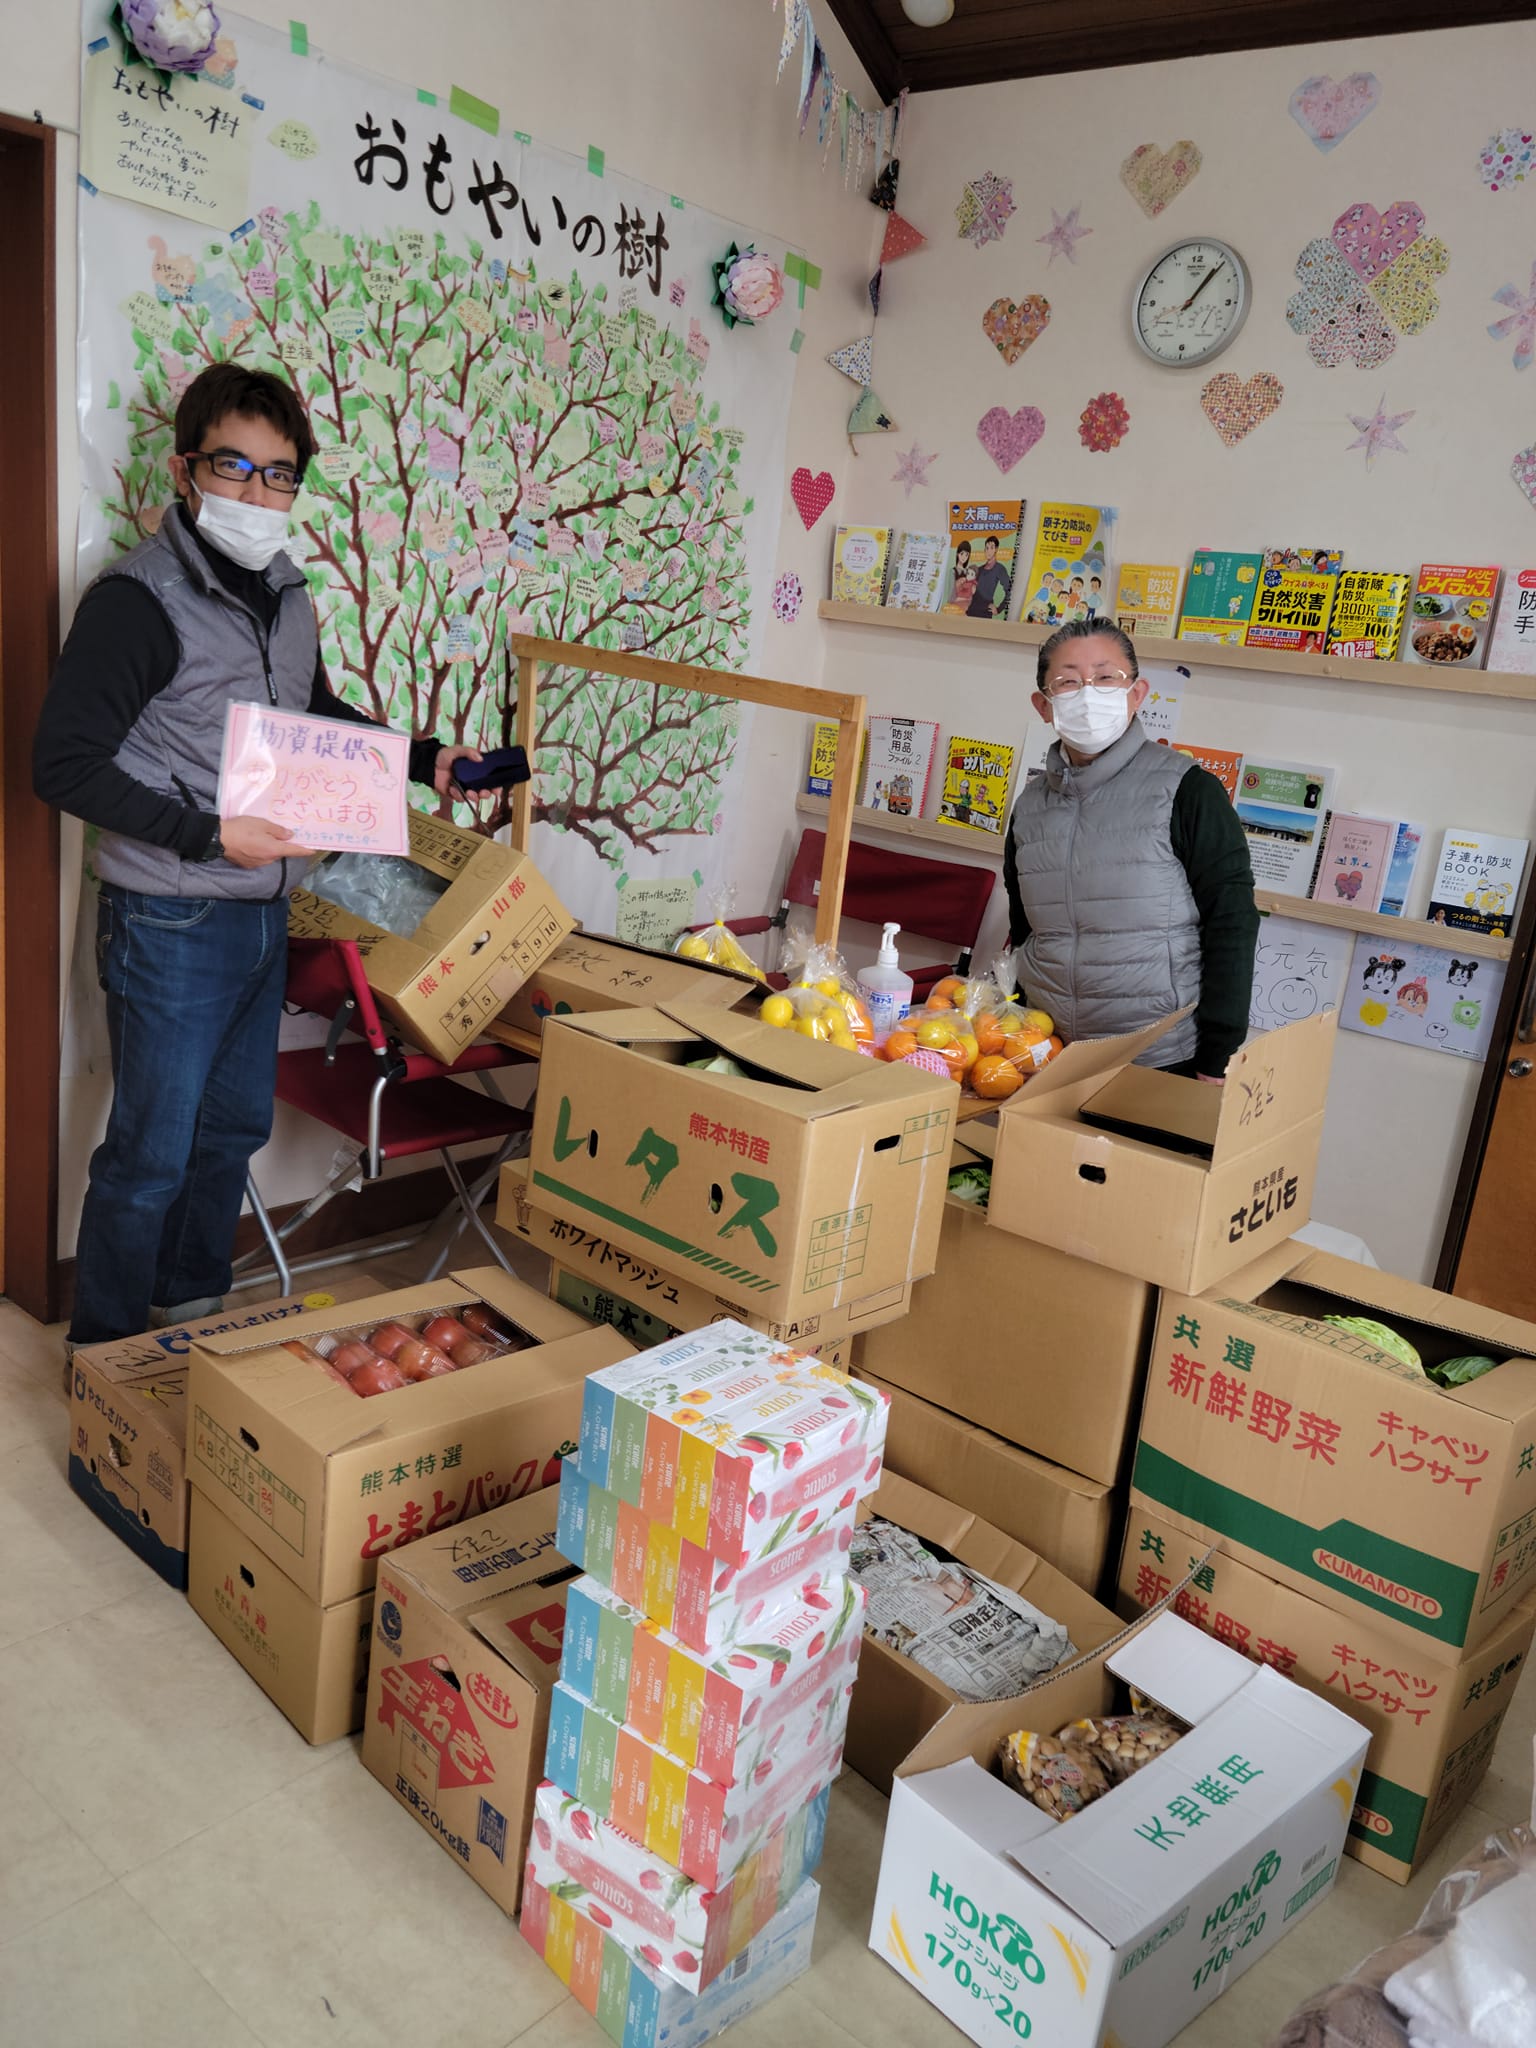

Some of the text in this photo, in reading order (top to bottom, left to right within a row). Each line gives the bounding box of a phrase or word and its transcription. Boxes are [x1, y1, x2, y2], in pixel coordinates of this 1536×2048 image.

[112, 66, 240, 138] おもやいの樹
[353, 112, 671, 297] おもやいの樹
[1191, 255, 1204, 263] 12
[1043, 516, 1092, 533] 原子力防災の
[1043, 530, 1069, 542] てびき
[905, 571, 924, 583] 防災
[908, 559, 927, 570] 親子
[1467, 569, 1494, 580] レシピ
[1148, 578, 1173, 594] 防災
[1260, 588, 1326, 612] 自然災害
[1342, 590, 1365, 602] 防災
[1344, 577, 1385, 591] 自衛隊
[1146, 595, 1171, 610] 手帖
[1258, 607, 1321, 627] サバイバル
[1340, 602, 1376, 616] BOOK
[1364, 623, 1394, 638] 100
[1514, 615, 1534, 634] 手
[1331, 641, 1356, 658] 30
[1356, 640, 1375, 650] 万部
[255, 718, 370, 762] 物資提供
[891, 740, 912, 753] 用品
[892, 728, 914, 742] 防災
[969, 747, 991, 758] ぼくらの
[816, 748, 837, 763] 防災
[888, 754, 922, 766] ファイル 2
[963, 755, 1006, 778] サバイバル
[247, 763, 358, 800] ありがとう
[272, 793, 379, 831] ございます
[1444, 862, 1490, 877] BOOK
[1446, 849, 1512, 869] 子連れ防災
[417, 875, 527, 999] 熊本 山都
[533, 938, 542, 949] 9
[544, 922, 557, 936] 10
[521, 953, 530, 963] 8
[482, 996, 491, 1006] 5
[460, 1015, 473, 1033] 秀
[687, 1112, 772, 1166] 熊本特産
[552, 1095, 781, 1258] レタス
[1252, 1166, 1285, 1197] 熊本県産
[1229, 1176, 1299, 1244] さといも
[549, 1218, 680, 1305] ホワイトマッシュ
[811, 1258, 818, 1270] L
[812, 1240, 824, 1253] LL
[808, 1275, 819, 1288] M
[199, 1304, 304, 1337] やさしさバナナ
[593, 1292, 640, 1335] 熊本
[788, 1321, 799, 1339] A
[658, 1343, 705, 1365] scottie
[1171, 1314, 1257, 1372] 共選
[689, 1358, 736, 1382] scottie
[720, 1374, 768, 1399] scottie
[87, 1385, 138, 1443] やさしさバナナ
[752, 1391, 803, 1417] scottie
[786, 1407, 837, 1434] scottie
[1166, 1353, 1342, 1466] 新鮮野菜
[590, 1405, 604, 1464] FLOWERBOX
[624, 1422, 635, 1481] FLOWERBOX
[1378, 1411, 1490, 1466] キャベツ
[360, 1443, 463, 1497] 熊本特選
[656, 1441, 668, 1501] FLOWERBOX
[803, 1468, 837, 1499] scottie
[1369, 1440, 1482, 1497] ハクサイ
[360, 1459, 539, 1560] とまとパック
[569, 1484, 579, 1543] FLOWERBOX
[724, 1480, 737, 1543] FLOWERBOX
[596, 1504, 608, 1562] FLOWERBOX
[627, 1523, 639, 1582] FLOWERBOX
[769, 1546, 806, 1577] scottie
[1139, 1528, 1217, 1595] 共選
[689, 1566, 701, 1625] FLOWERBOX
[1318, 1550, 1439, 1619] KUMAMOTO
[576, 1615, 588, 1673] FLOWERBOX
[772, 1613, 821, 1648] scottie
[610, 1635, 620, 1695] FLOWERBOX
[1331, 1643, 1440, 1700] キャベツ
[420, 1678, 455, 1714] 北見
[471, 1672, 514, 1717] 共計
[644, 1657, 656, 1716] FLOWERBOX
[1324, 1670, 1432, 1728] ハクサイ
[382, 1667, 496, 1783] 玉ねぎ
[560, 1714, 571, 1771] FLOWERBOX
[715, 1701, 728, 1761] FLOWERBOX
[595, 1735, 605, 1793] FLOWERBOX
[628, 1759, 639, 1817] FLOWERBOX
[1133, 1753, 1265, 1853] 天地無用
[396, 1773, 471, 1863] 正味20kg詰
[698, 1805, 710, 1865] FLOWERBOX
[591, 1872, 635, 1915] scottie
[1210, 1895, 1263, 1952] ブナシメジ
[944, 1920, 1021, 1992] ブナシメジ
